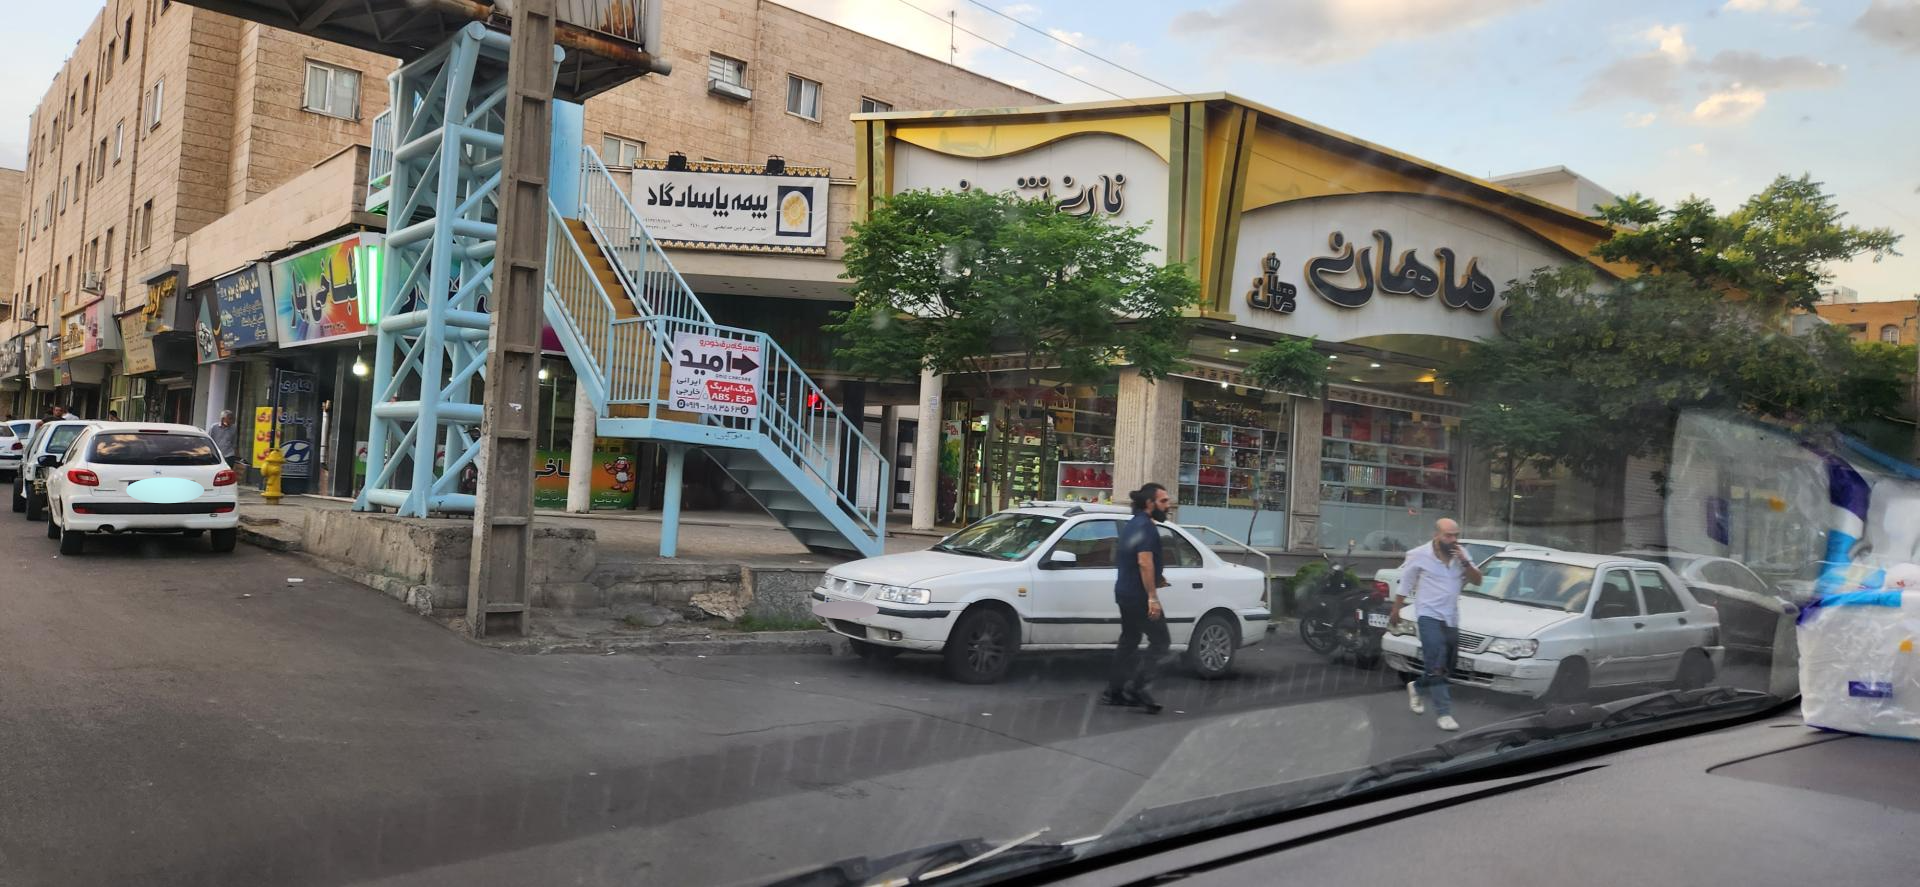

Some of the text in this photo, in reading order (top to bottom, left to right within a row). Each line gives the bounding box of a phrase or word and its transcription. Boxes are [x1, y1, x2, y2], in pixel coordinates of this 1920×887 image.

[647, 182, 768, 219] بیمه پاسارگاد
[1304, 229, 1496, 312] ماهان
[699, 339, 760, 352] تعمیرگاه برق خودرو
[680, 349, 732, 376] امید
[677, 377, 701, 385] ایرانی
[675, 388, 700, 396] خارجی
[735, 395, 752, 403] ESP
